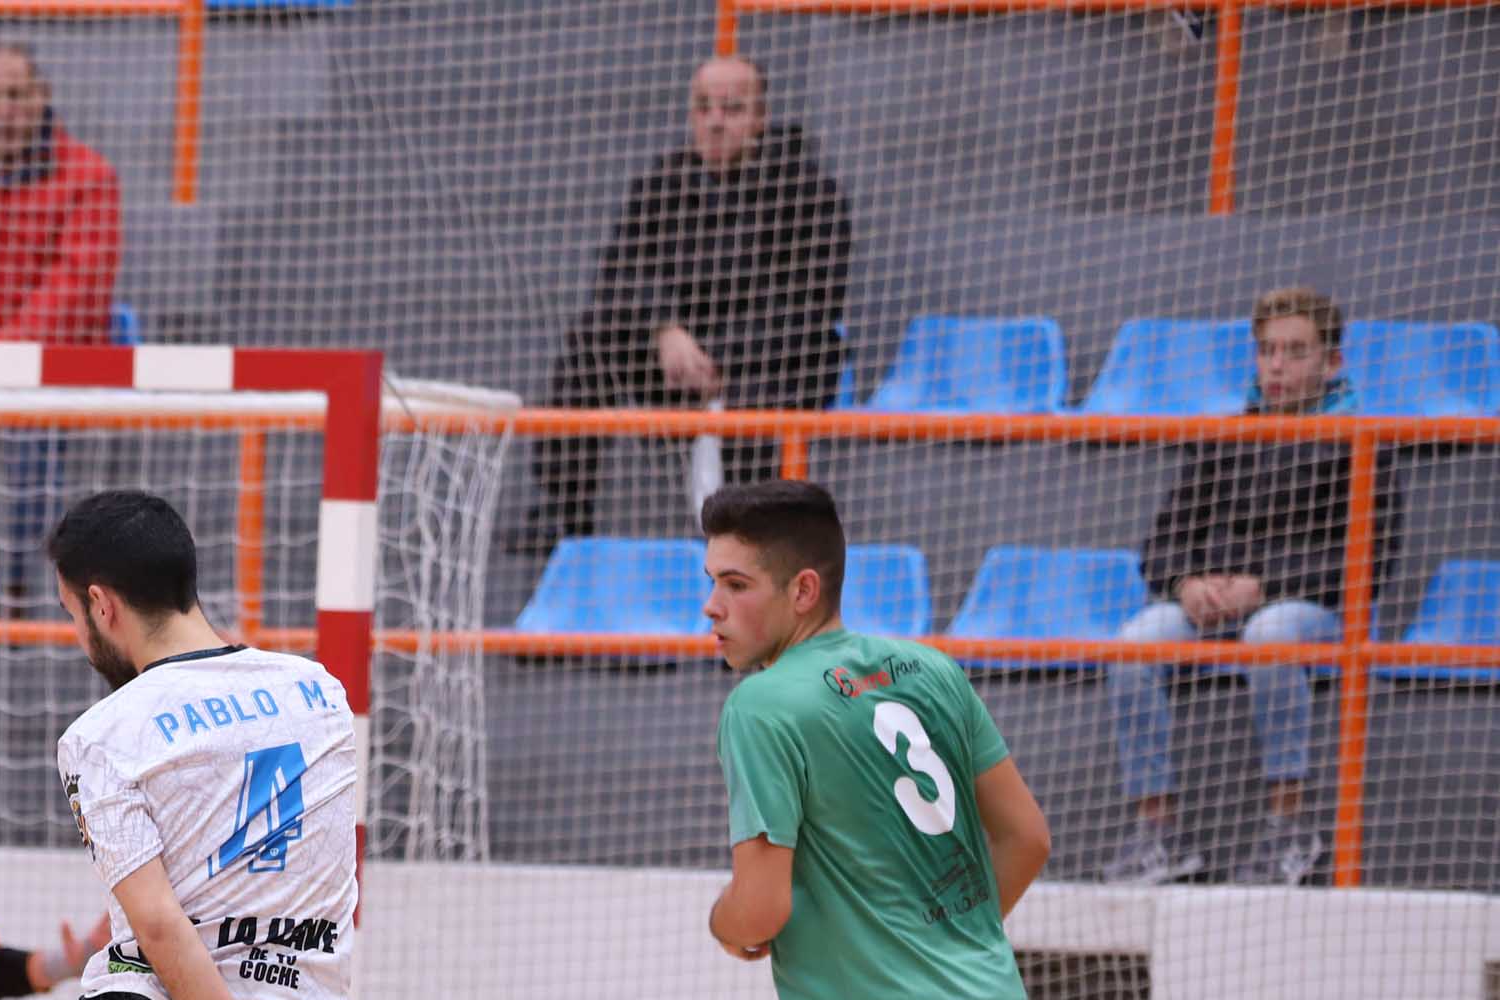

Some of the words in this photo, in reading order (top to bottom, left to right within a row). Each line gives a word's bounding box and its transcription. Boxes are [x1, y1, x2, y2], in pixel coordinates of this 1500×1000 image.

[152, 688, 280, 745] PABLO
[295, 679, 338, 712] M.
[873, 701, 956, 836] 3
[206, 741, 308, 881] 4
[218, 916, 257, 948] LA
[248, 946, 269, 961] DE
[276, 953, 297, 966] TU
[239, 960, 300, 990] COCHE
